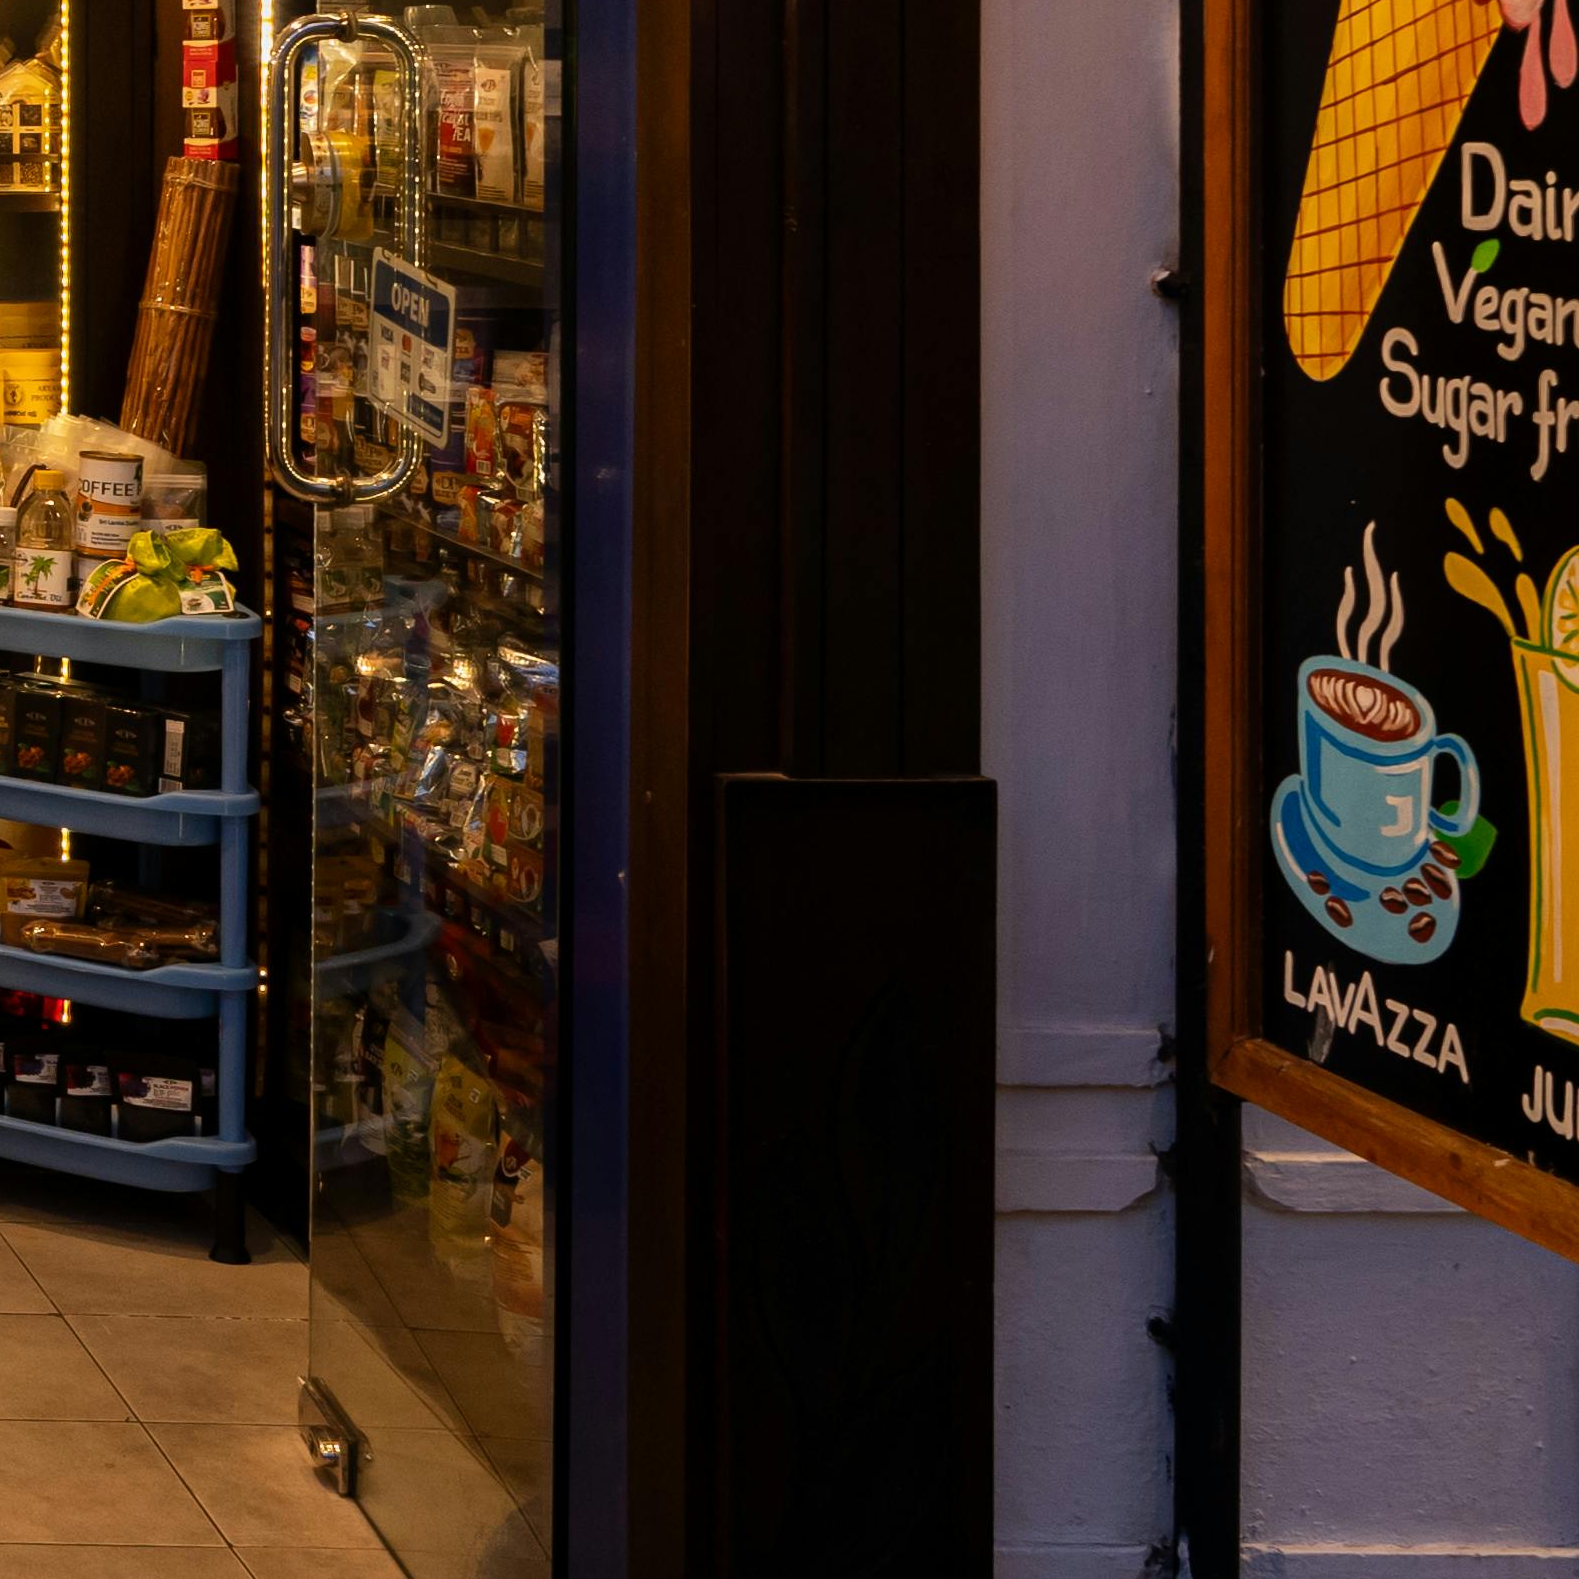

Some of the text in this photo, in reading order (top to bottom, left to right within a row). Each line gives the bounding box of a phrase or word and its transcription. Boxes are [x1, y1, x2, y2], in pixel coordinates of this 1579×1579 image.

[391, 283, 430, 327] OPEN
[1432, 238, 1579, 361] Vegan
[1379, 327, 1523, 469] Sugar
[1284, 950, 1469, 1083] LAVAZZA
[1522, 1065, 1579, 1141] JU
